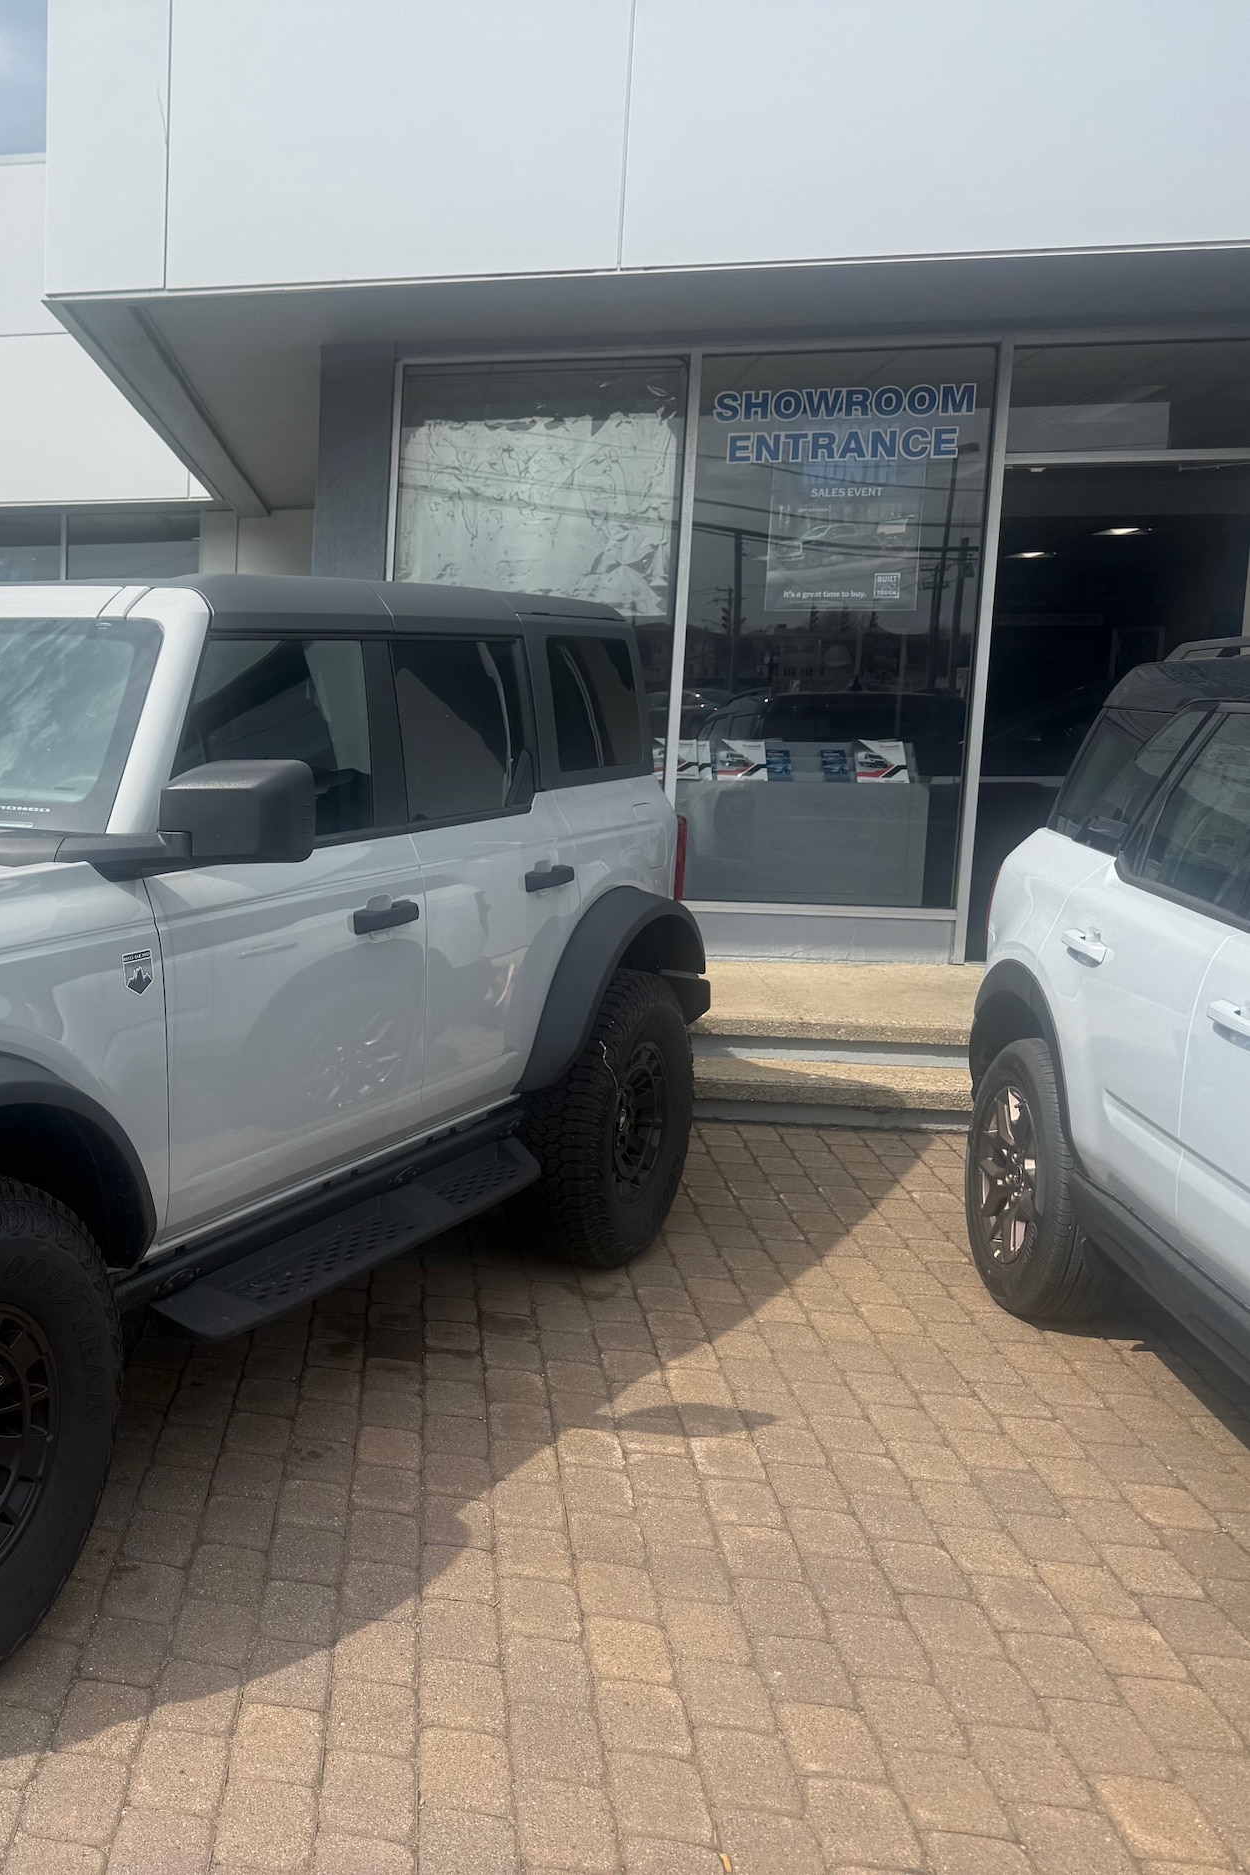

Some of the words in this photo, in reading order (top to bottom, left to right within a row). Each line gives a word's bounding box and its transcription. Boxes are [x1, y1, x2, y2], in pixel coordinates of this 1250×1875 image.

[714, 383, 977, 422] SHOWROOM
[727, 426, 959, 463] ENTRANCE
[811, 488, 845, 498] SALES
[847, 487, 883, 497] EVENT
[877, 575, 898, 583] BUILT
[802, 591, 822, 599] great
[823, 590, 840, 598] time
[851, 590, 867, 599] buy.
